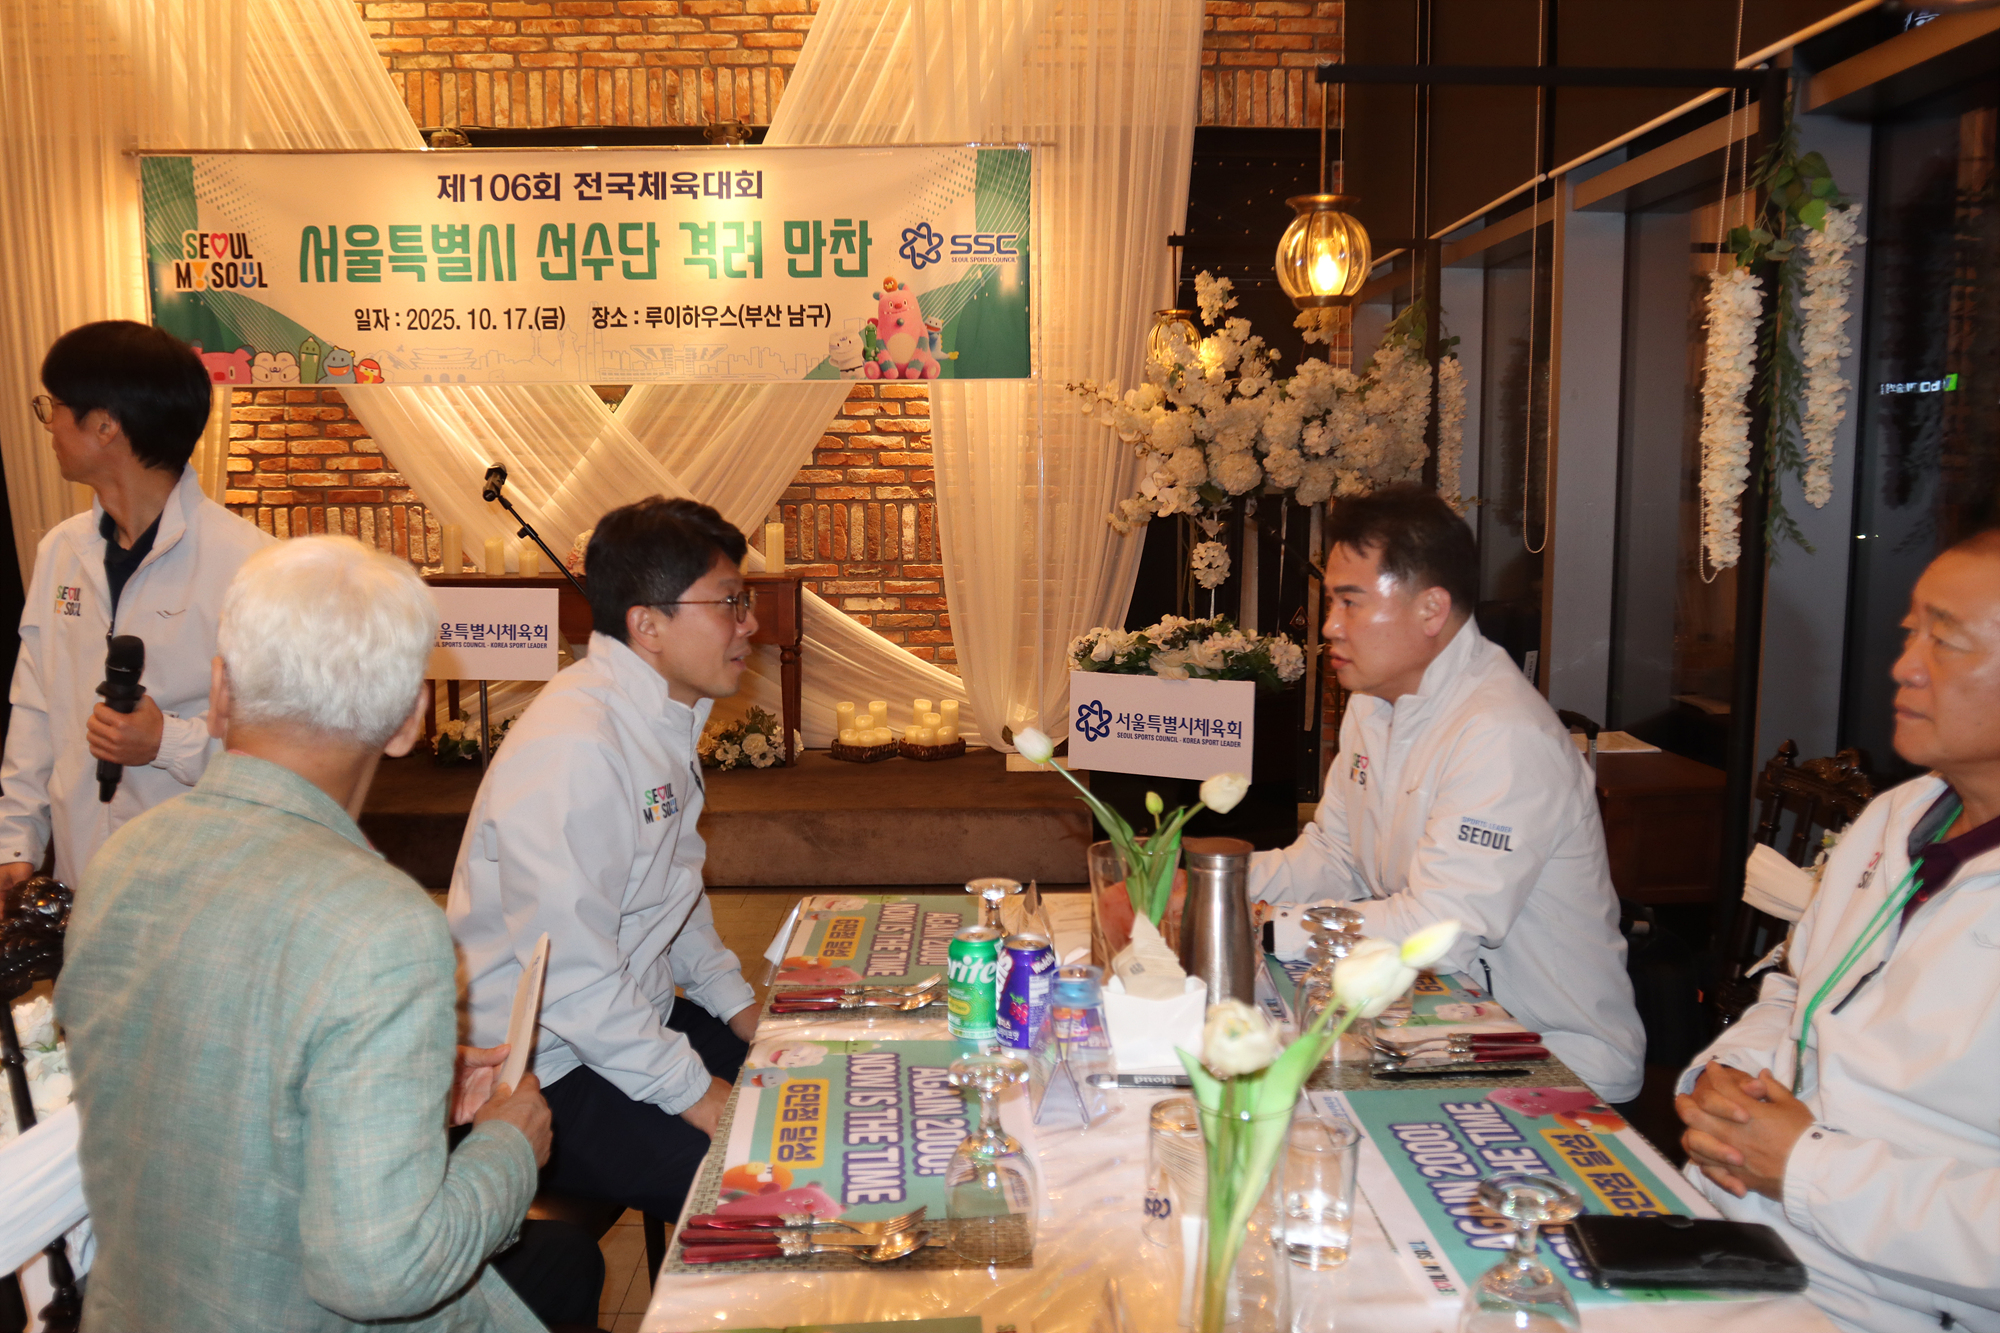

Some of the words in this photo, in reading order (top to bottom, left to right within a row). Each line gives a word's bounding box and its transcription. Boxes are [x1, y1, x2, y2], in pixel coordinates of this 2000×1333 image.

[437, 171, 562, 203] 제106회
[573, 169, 764, 201] 전국체육대회
[299, 222, 517, 283] 서울특별시
[535, 221, 660, 282] 선수단
[678, 220, 763, 280] 격려
[784, 218, 873, 279] 만찬
[950, 234, 1018, 255] SSC
[211, 261, 268, 289] SOUL
[406, 308, 461, 331] 2025.
[468, 308, 498, 331] 10.
[503, 306, 566, 331] 17.(금)
[644, 304, 783, 329] 루이하우스(부산
[786, 303, 831, 329] 남구)
[435, 622, 548, 641] 울특별시체육회
[490, 641, 508, 649] KOREA
[1116, 712, 1242, 740] 서울특별시체육회
[1117, 731, 1134, 740] SEOUL
[1134, 733, 1155, 742] SPORTS
[1155, 735, 1178, 743] COUNCIL
[1182, 737, 1201, 745] KOREA
[1201, 738, 1219, 747] SPORT
[1220, 740, 1242, 748] LEADER
[1458, 824, 1513, 852] SEOUL
[1462, 816, 1488, 828] SPORTS
[1488, 823, 1513, 834] LEADER
[878, 903, 920, 923] NOW
[868, 933, 914, 951] THE
[874, 922, 919, 934] IS
[862, 951, 912, 977] TIME
[947, 955, 997, 984] rite
[847, 1053, 901, 1089] NOW
[1133, 1075, 1177, 1085] Kloud
[782, 1083, 822, 1122] 6만점
[845, 1089, 901, 1108] IS
[908, 1065, 969, 1116] AGAIN
[844, 1107, 904, 1147] THE
[1440, 1101, 1528, 1148] TIME
[776, 1125, 818, 1163] 달성
[910, 1117, 972, 1178] 2000!
[1388, 1121, 1484, 1180] 2000!
[1550, 1133, 1615, 1169] 달성
[841, 1146, 907, 1205] TIME
